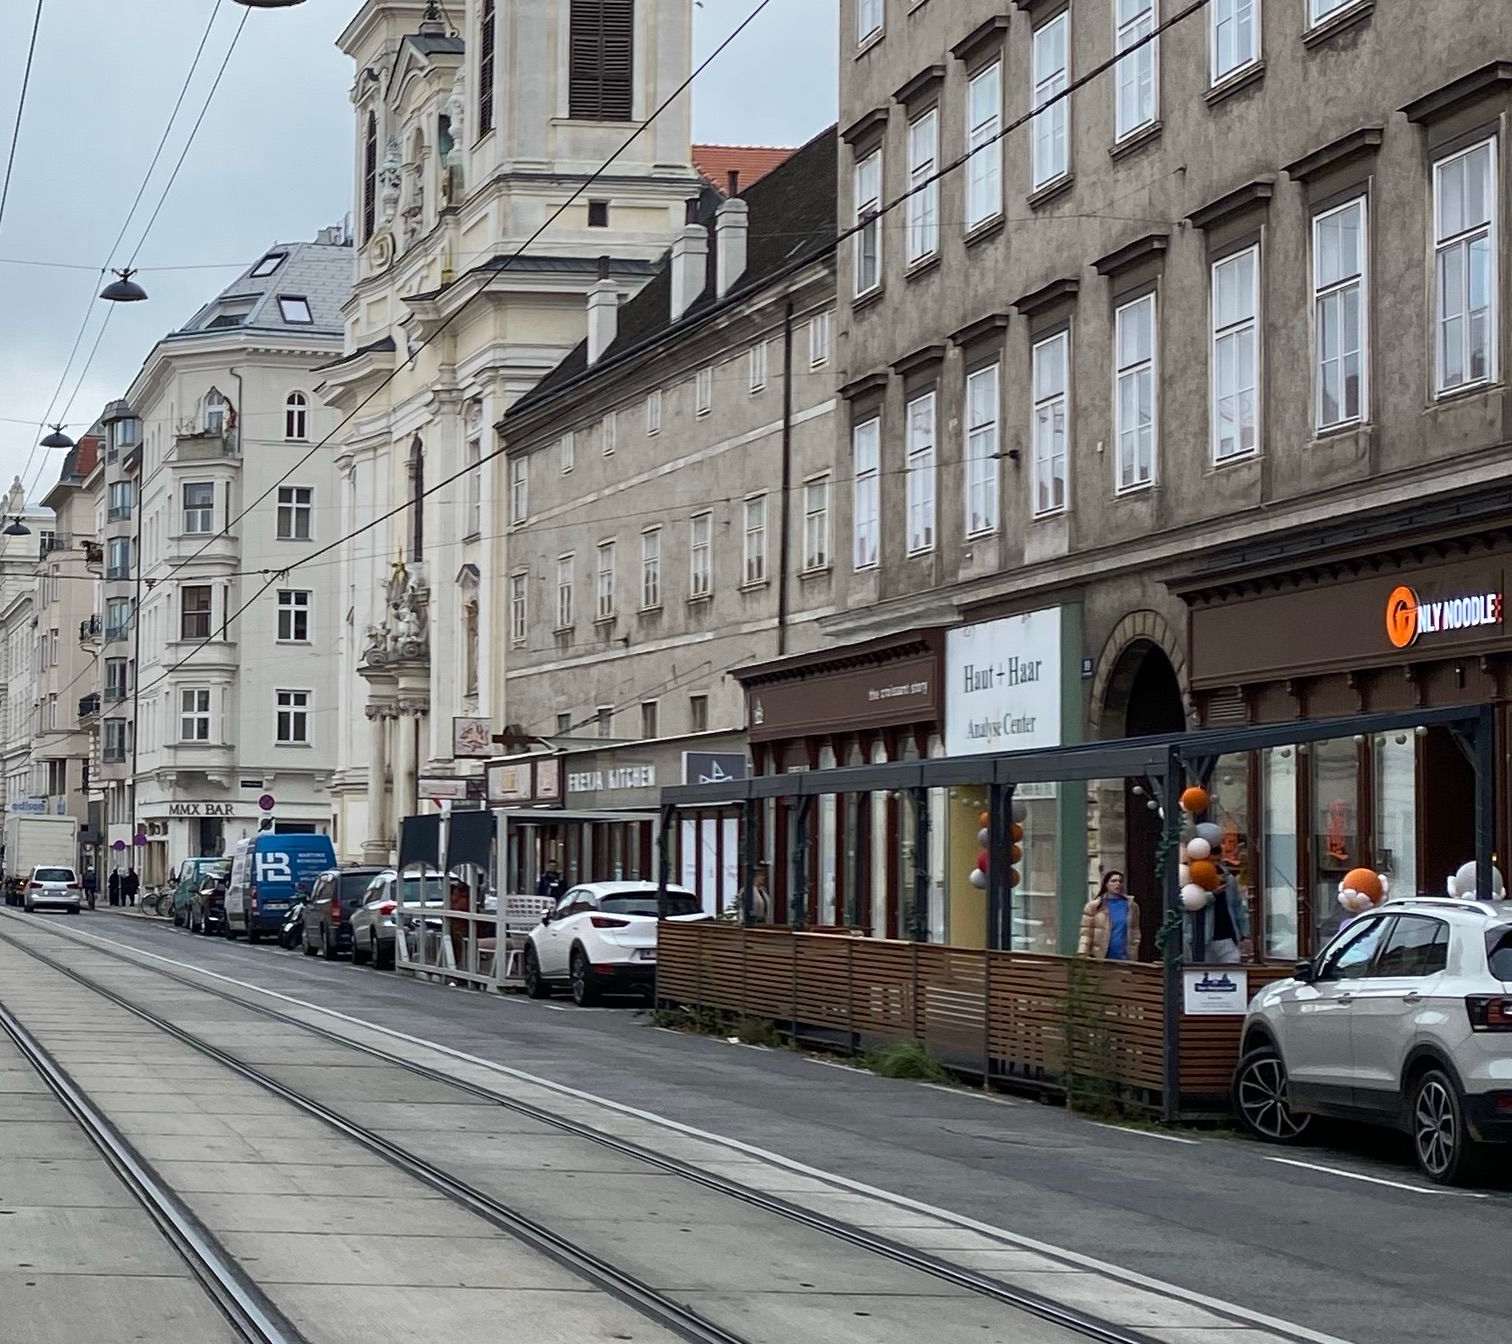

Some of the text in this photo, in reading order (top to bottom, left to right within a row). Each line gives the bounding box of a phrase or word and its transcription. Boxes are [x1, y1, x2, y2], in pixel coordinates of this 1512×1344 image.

[964, 664, 994, 694] Haut
[1008, 656, 1043, 687] Haar
[967, 713, 1037, 743] Analyse Center
[169, 804, 234, 815] MMX BAR
